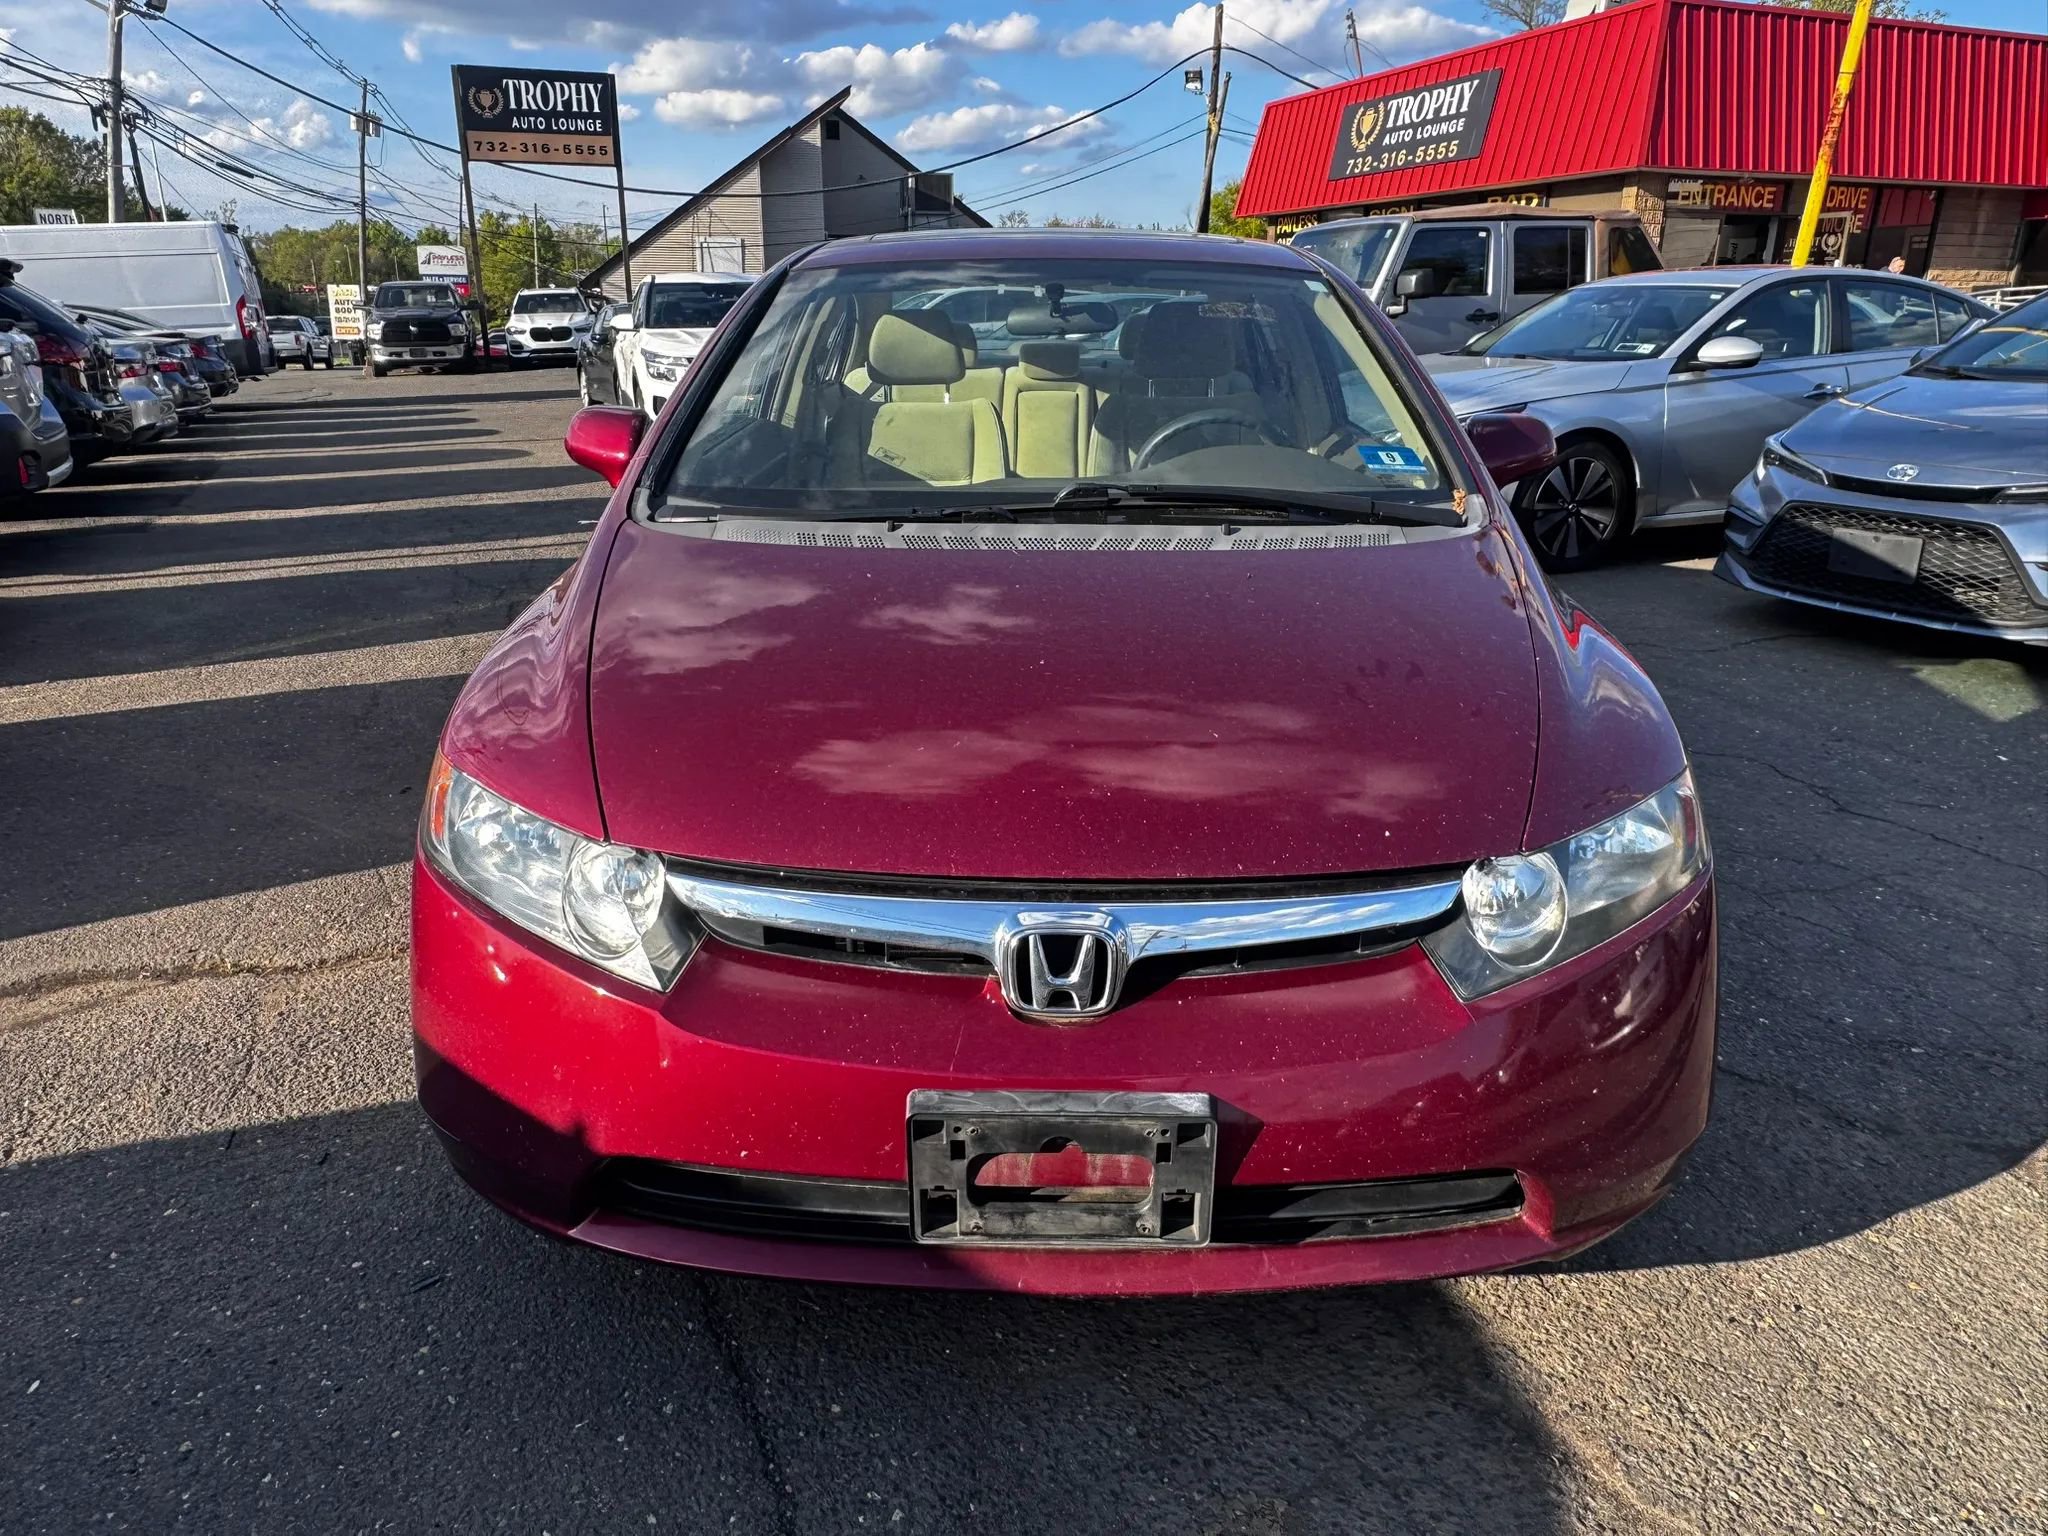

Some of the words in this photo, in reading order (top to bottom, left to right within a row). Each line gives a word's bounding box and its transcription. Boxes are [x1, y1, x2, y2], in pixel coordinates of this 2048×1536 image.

[502, 78, 603, 113] TROPHY
[1386, 79, 1480, 128] TROPHY
[512, 116, 545, 129] AUTO
[552, 118, 603, 132] LOUNGE
[1382, 130, 1413, 146] AUTO
[1416, 117, 1466, 140] LOUNGE
[473, 140, 609, 156] 732-316-5555
[1345, 140, 1460, 175] 732-316-5555
[1677, 184, 1777, 208] ENTRANCE
[1826, 186, 1869, 209] DRIVE
[39, 213, 77, 224] NORTH
[1277, 214, 1319, 234] PAYLESS
[1386, 452, 1396, 463] 9
